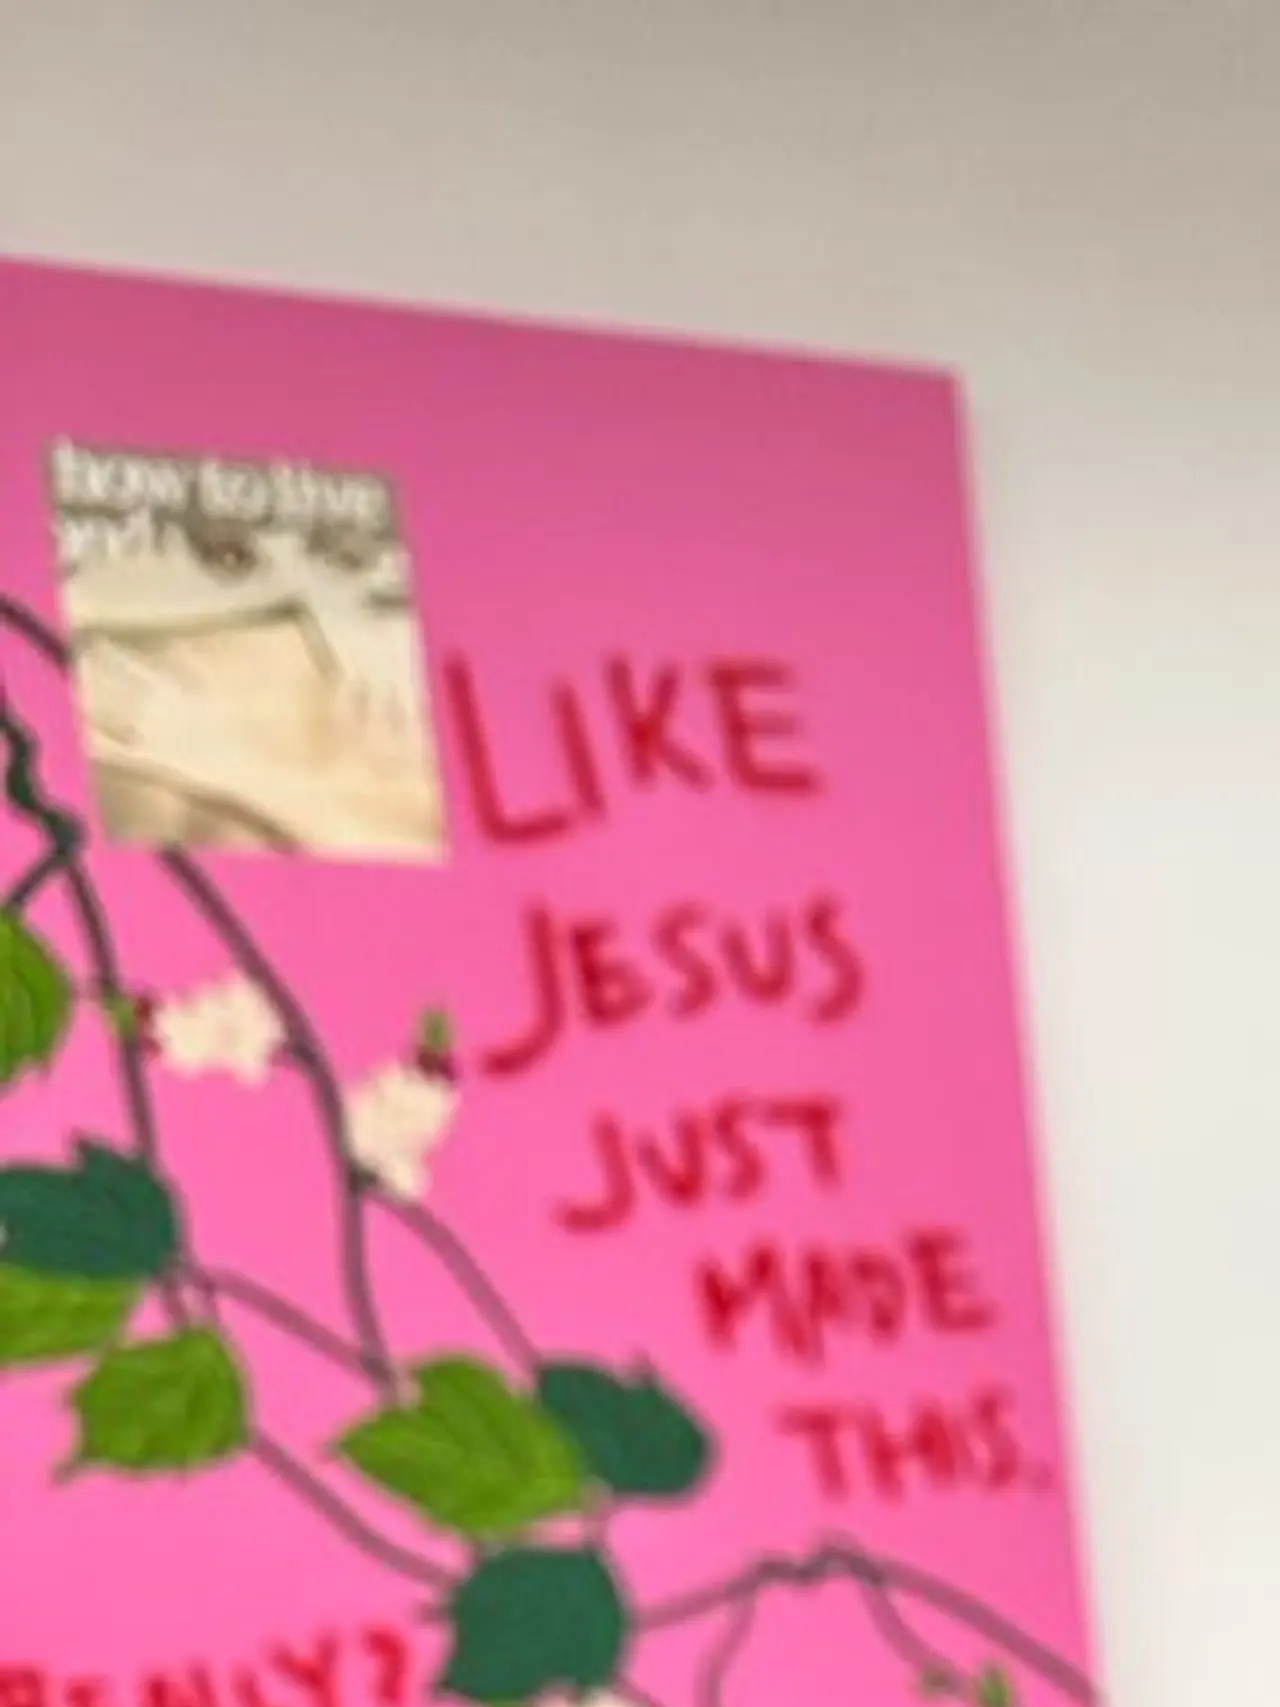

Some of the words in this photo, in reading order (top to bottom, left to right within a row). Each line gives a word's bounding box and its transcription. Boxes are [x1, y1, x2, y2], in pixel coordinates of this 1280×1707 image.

[446, 651, 824, 845] LIKE
[480, 892, 868, 1076] JESUS
[552, 1093, 844, 1232] JUST
[696, 1228, 1002, 1362] MADE
